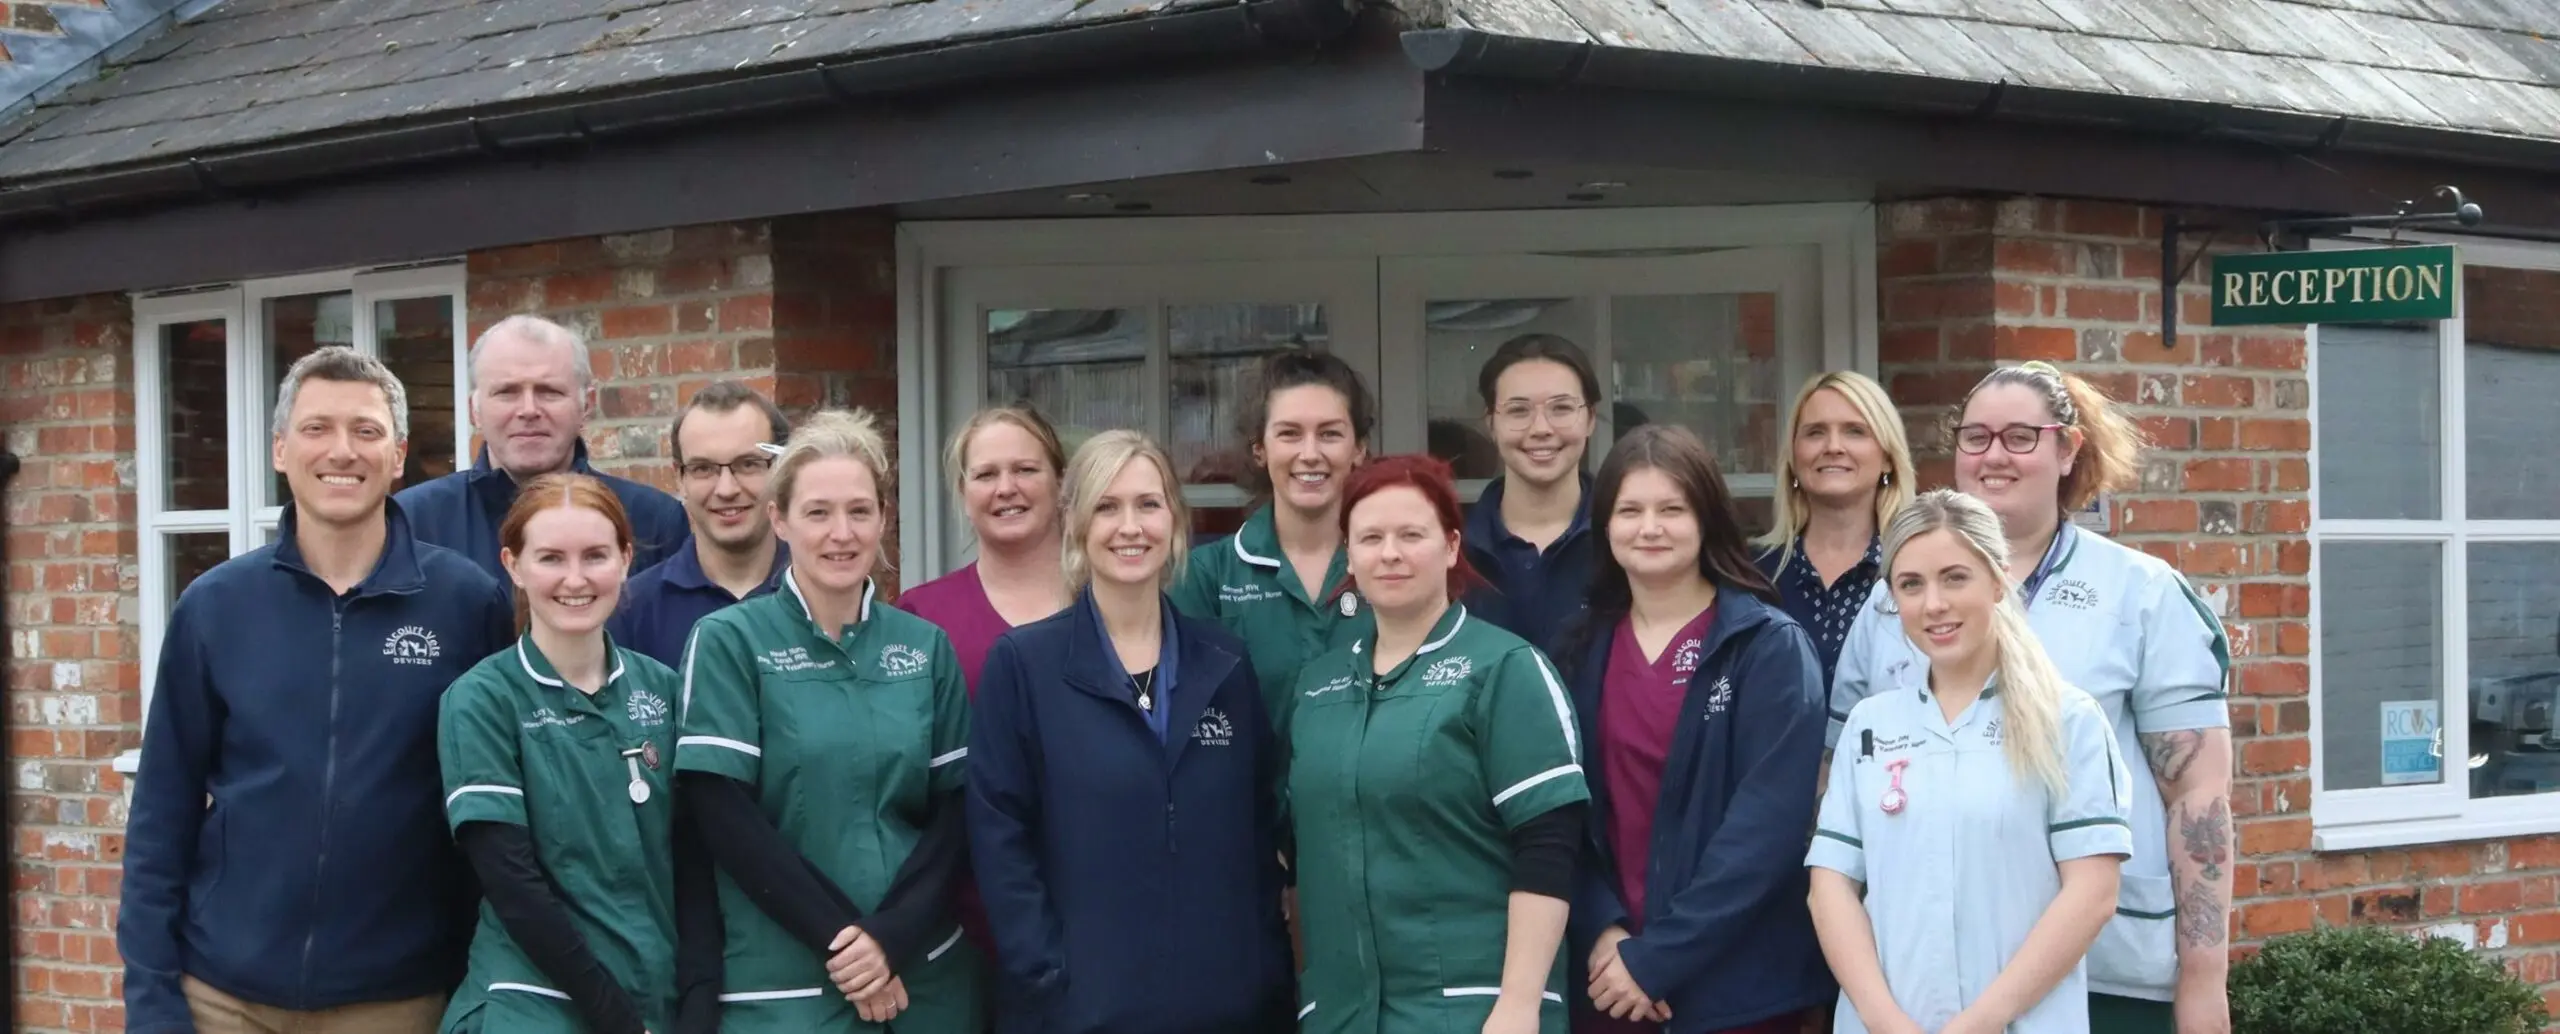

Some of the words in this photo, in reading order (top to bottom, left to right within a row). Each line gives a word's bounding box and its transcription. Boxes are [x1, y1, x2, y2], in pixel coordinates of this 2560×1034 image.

[2222, 264, 2444, 307] RECEPTION
[382, 625, 424, 655] Estcourt
[393, 657, 433, 665] DEVIZES
[2387, 708, 2434, 735] RCVS
